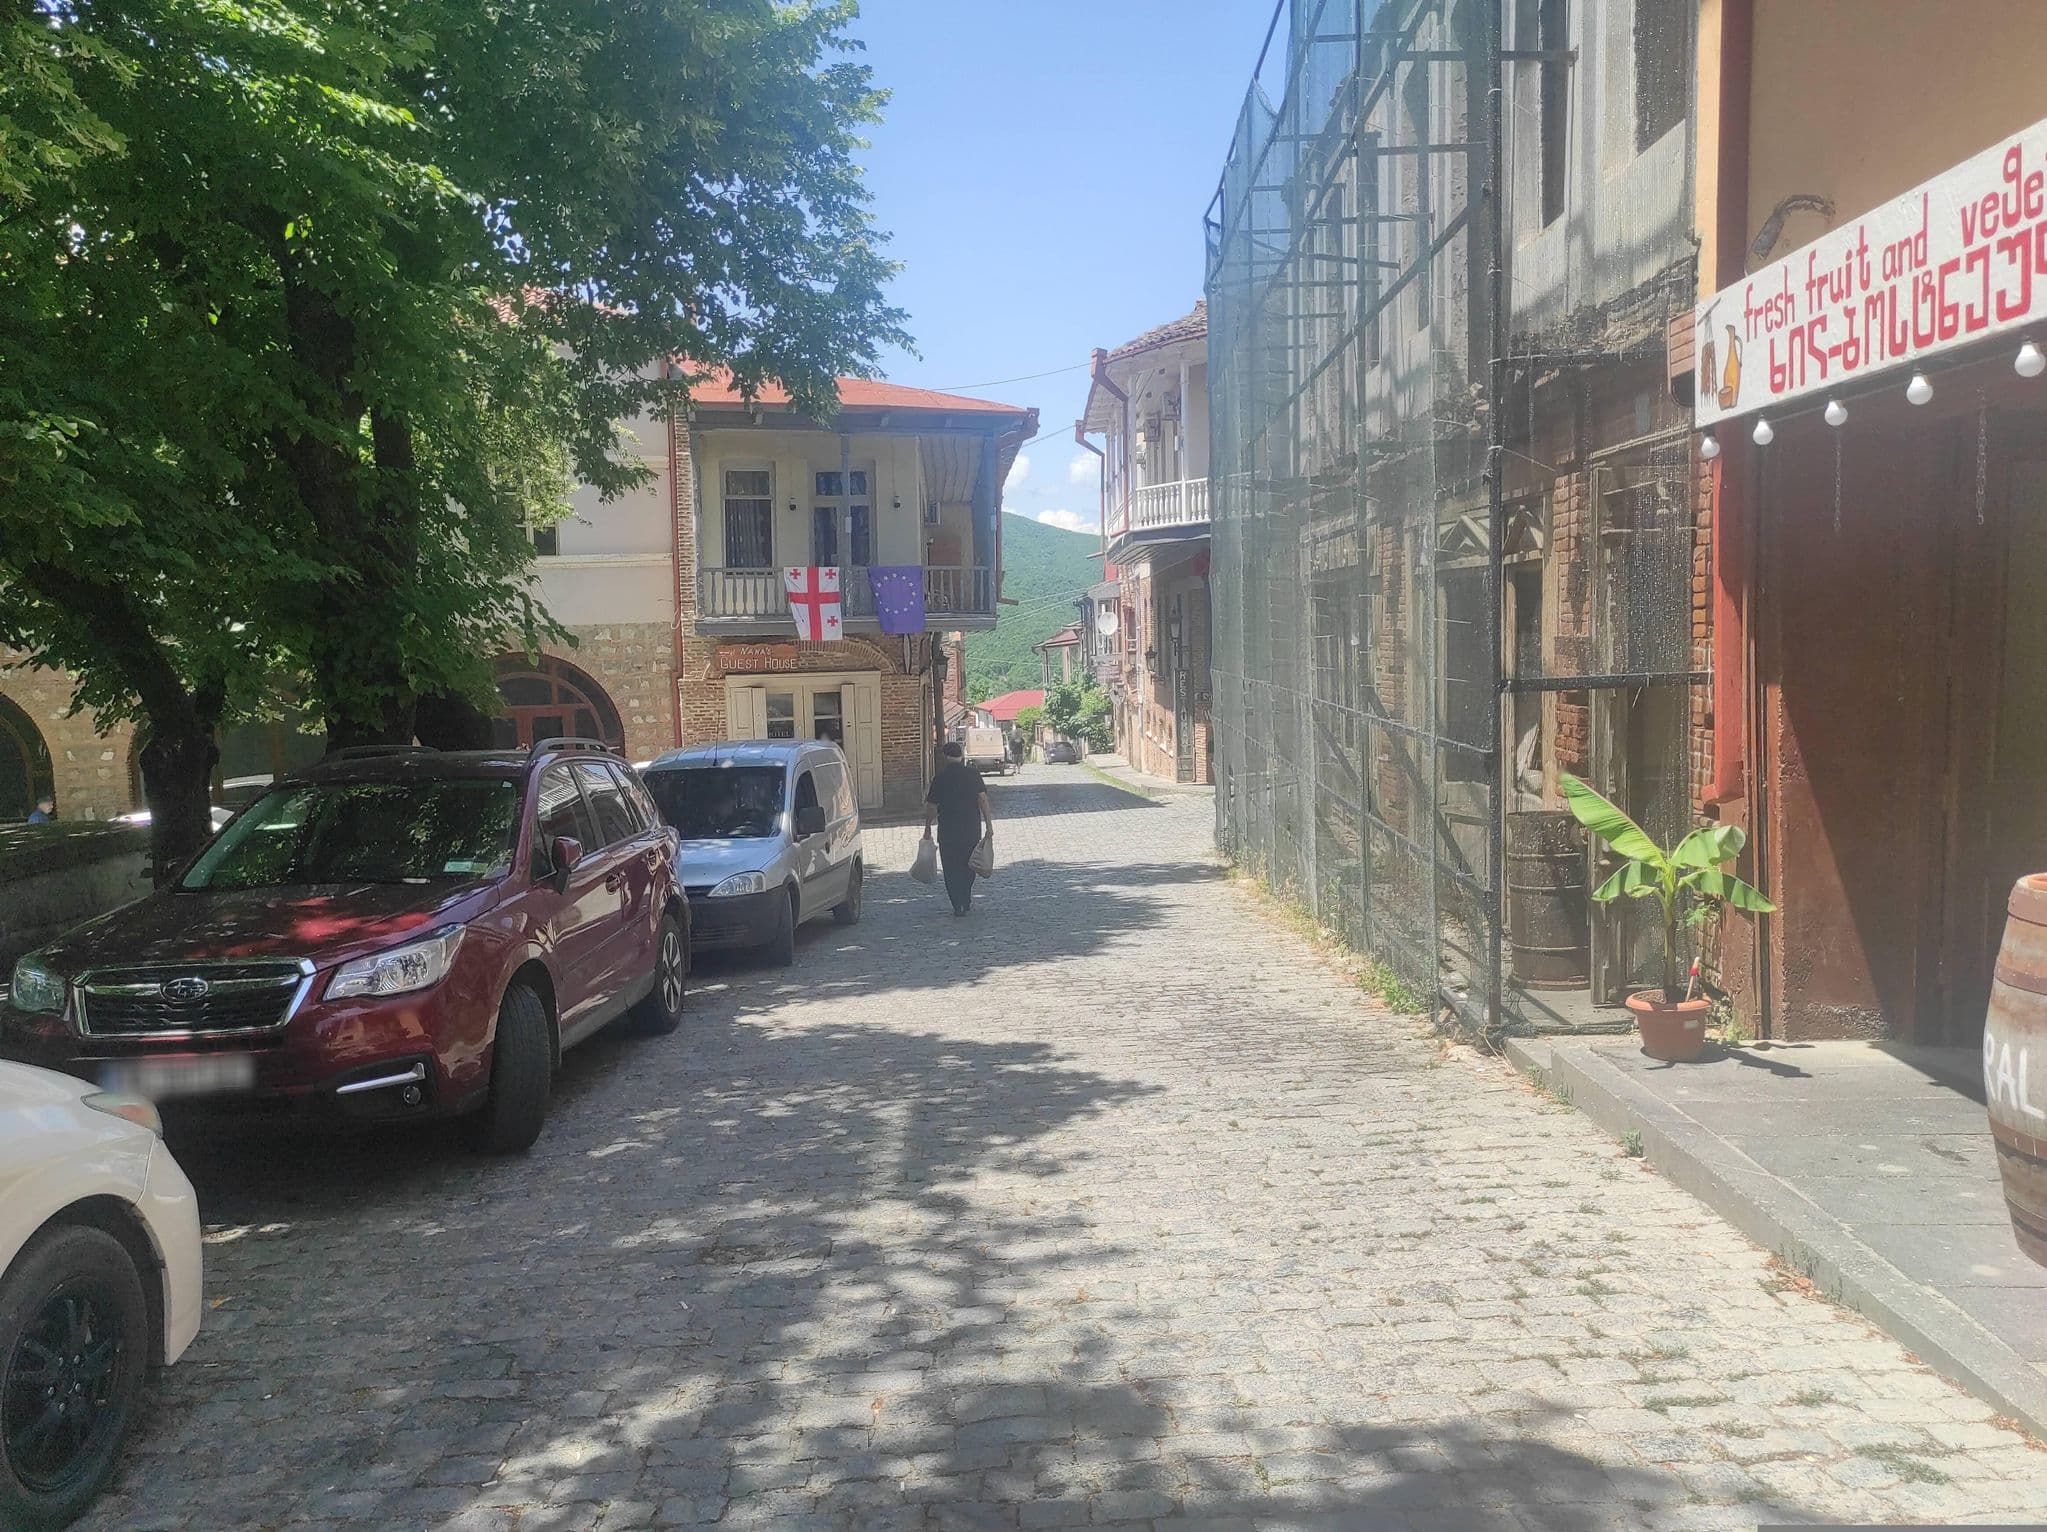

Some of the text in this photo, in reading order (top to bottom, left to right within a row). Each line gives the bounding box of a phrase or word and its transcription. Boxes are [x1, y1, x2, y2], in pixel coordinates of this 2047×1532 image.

[1743, 142, 2047, 343] fresh fruit and vege
[720, 656, 798, 669] GUEST HOUSE
